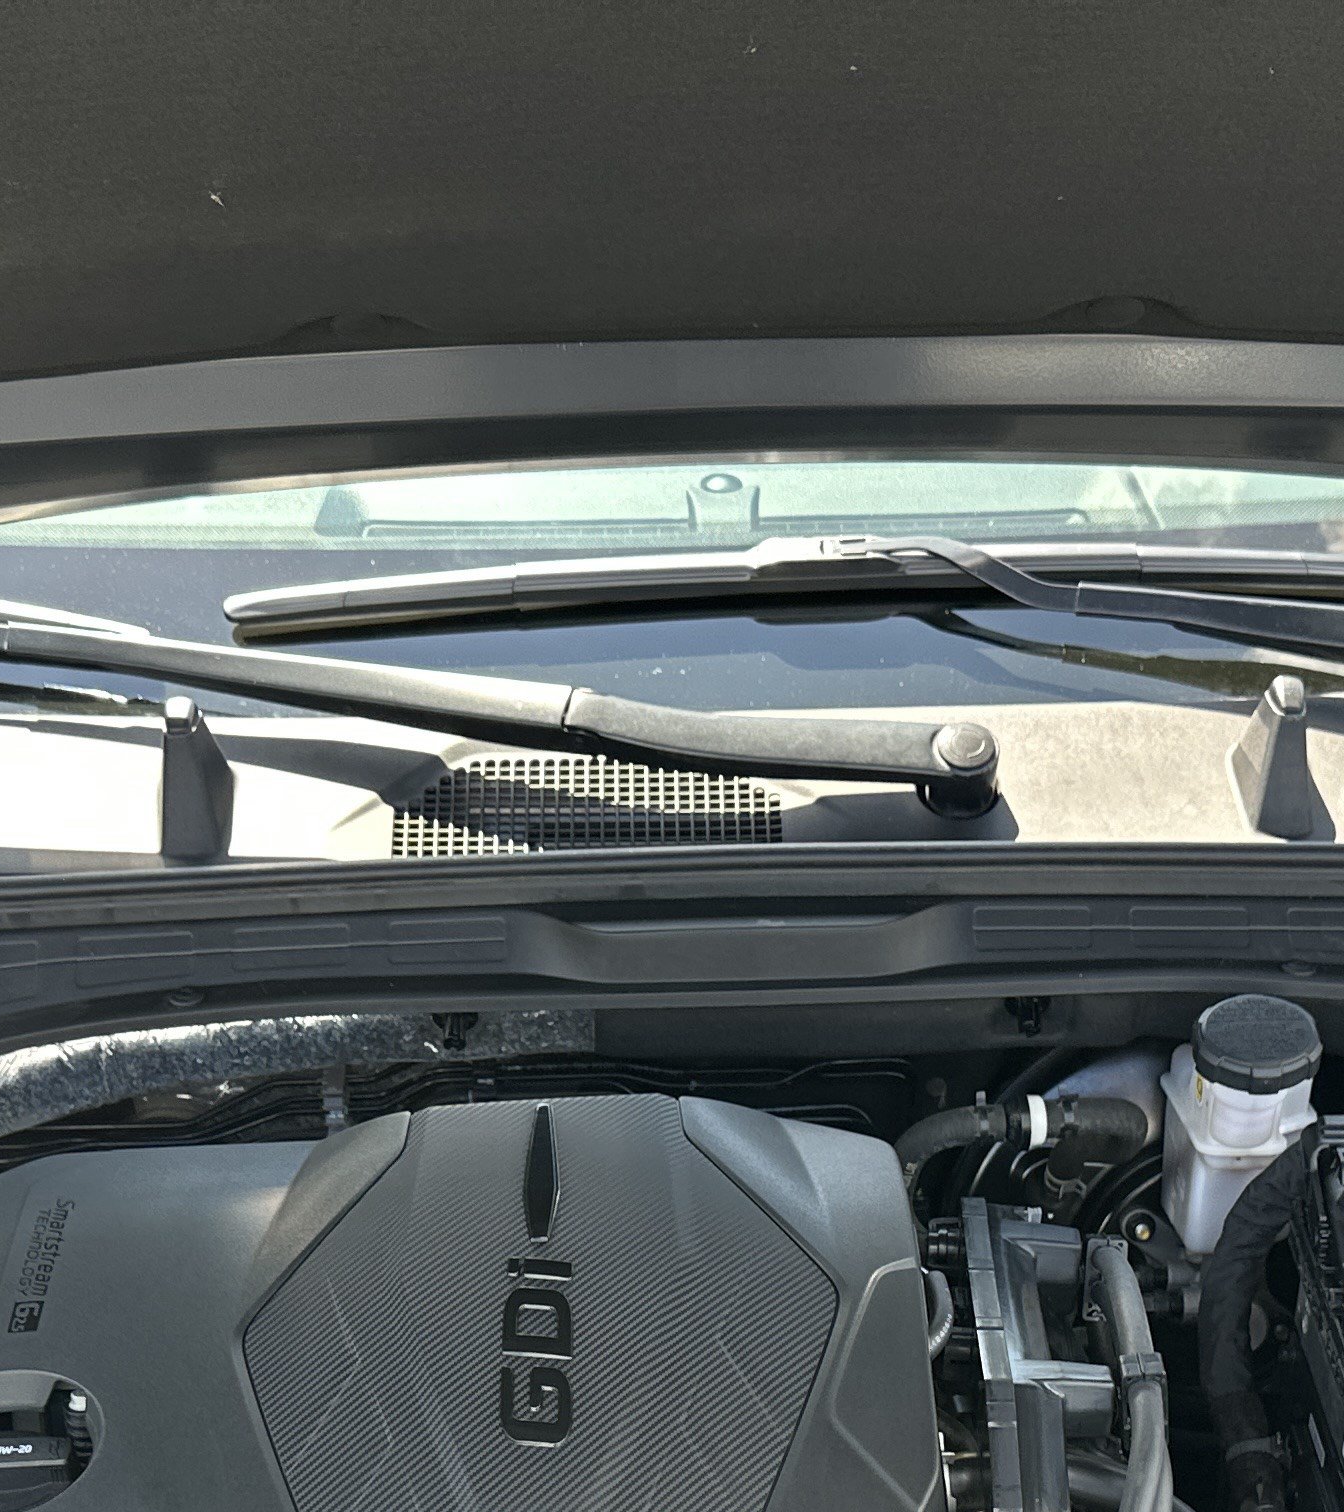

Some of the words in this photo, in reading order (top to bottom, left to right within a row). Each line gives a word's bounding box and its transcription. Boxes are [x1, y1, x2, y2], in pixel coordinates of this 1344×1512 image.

[16, 1209, 51, 1297] TECHNOLOGY
[32, 1198, 75, 1297] Smartstream
[500, 1258, 573, 1447] GDi
